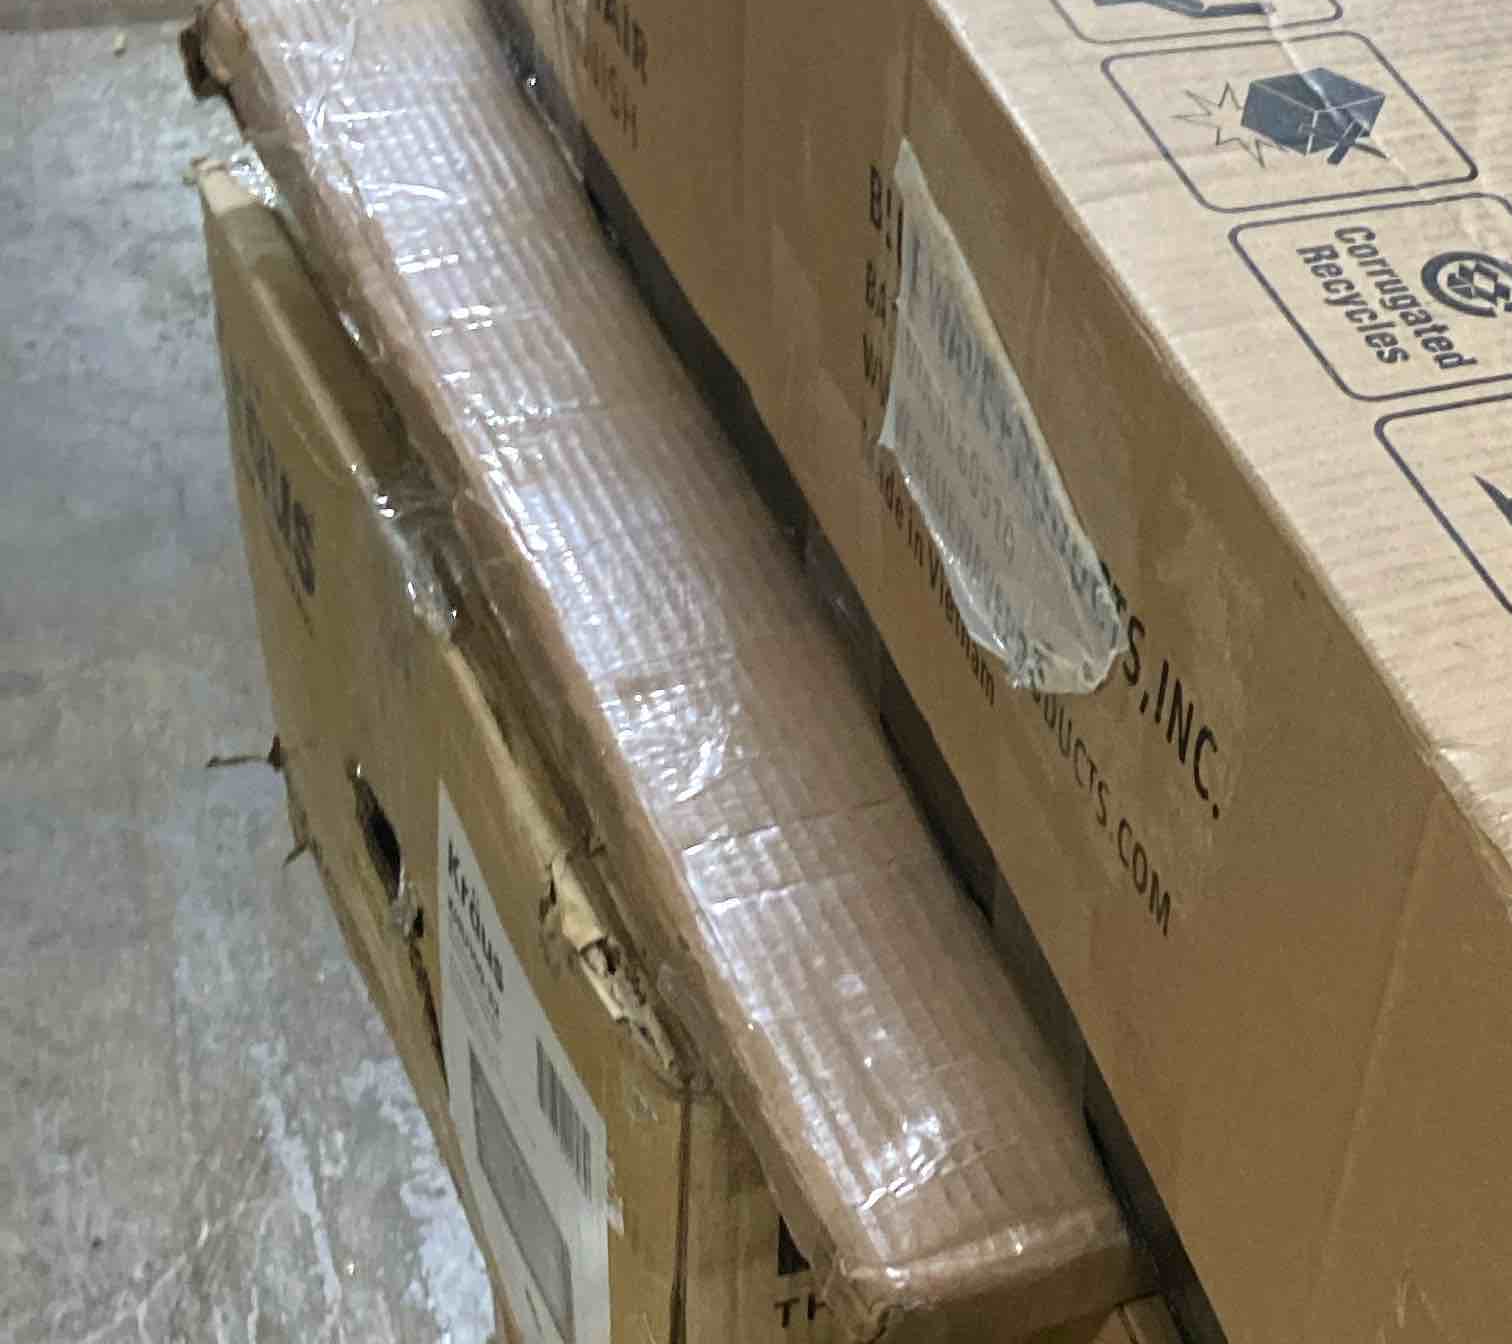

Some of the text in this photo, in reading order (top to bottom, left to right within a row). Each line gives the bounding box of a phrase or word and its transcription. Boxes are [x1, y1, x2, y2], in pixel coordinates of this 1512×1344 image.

[1296, 243, 1410, 364] Recycles
[1333, 224, 1478, 370] Corrugated
[928, 553, 996, 709] Vietnam
